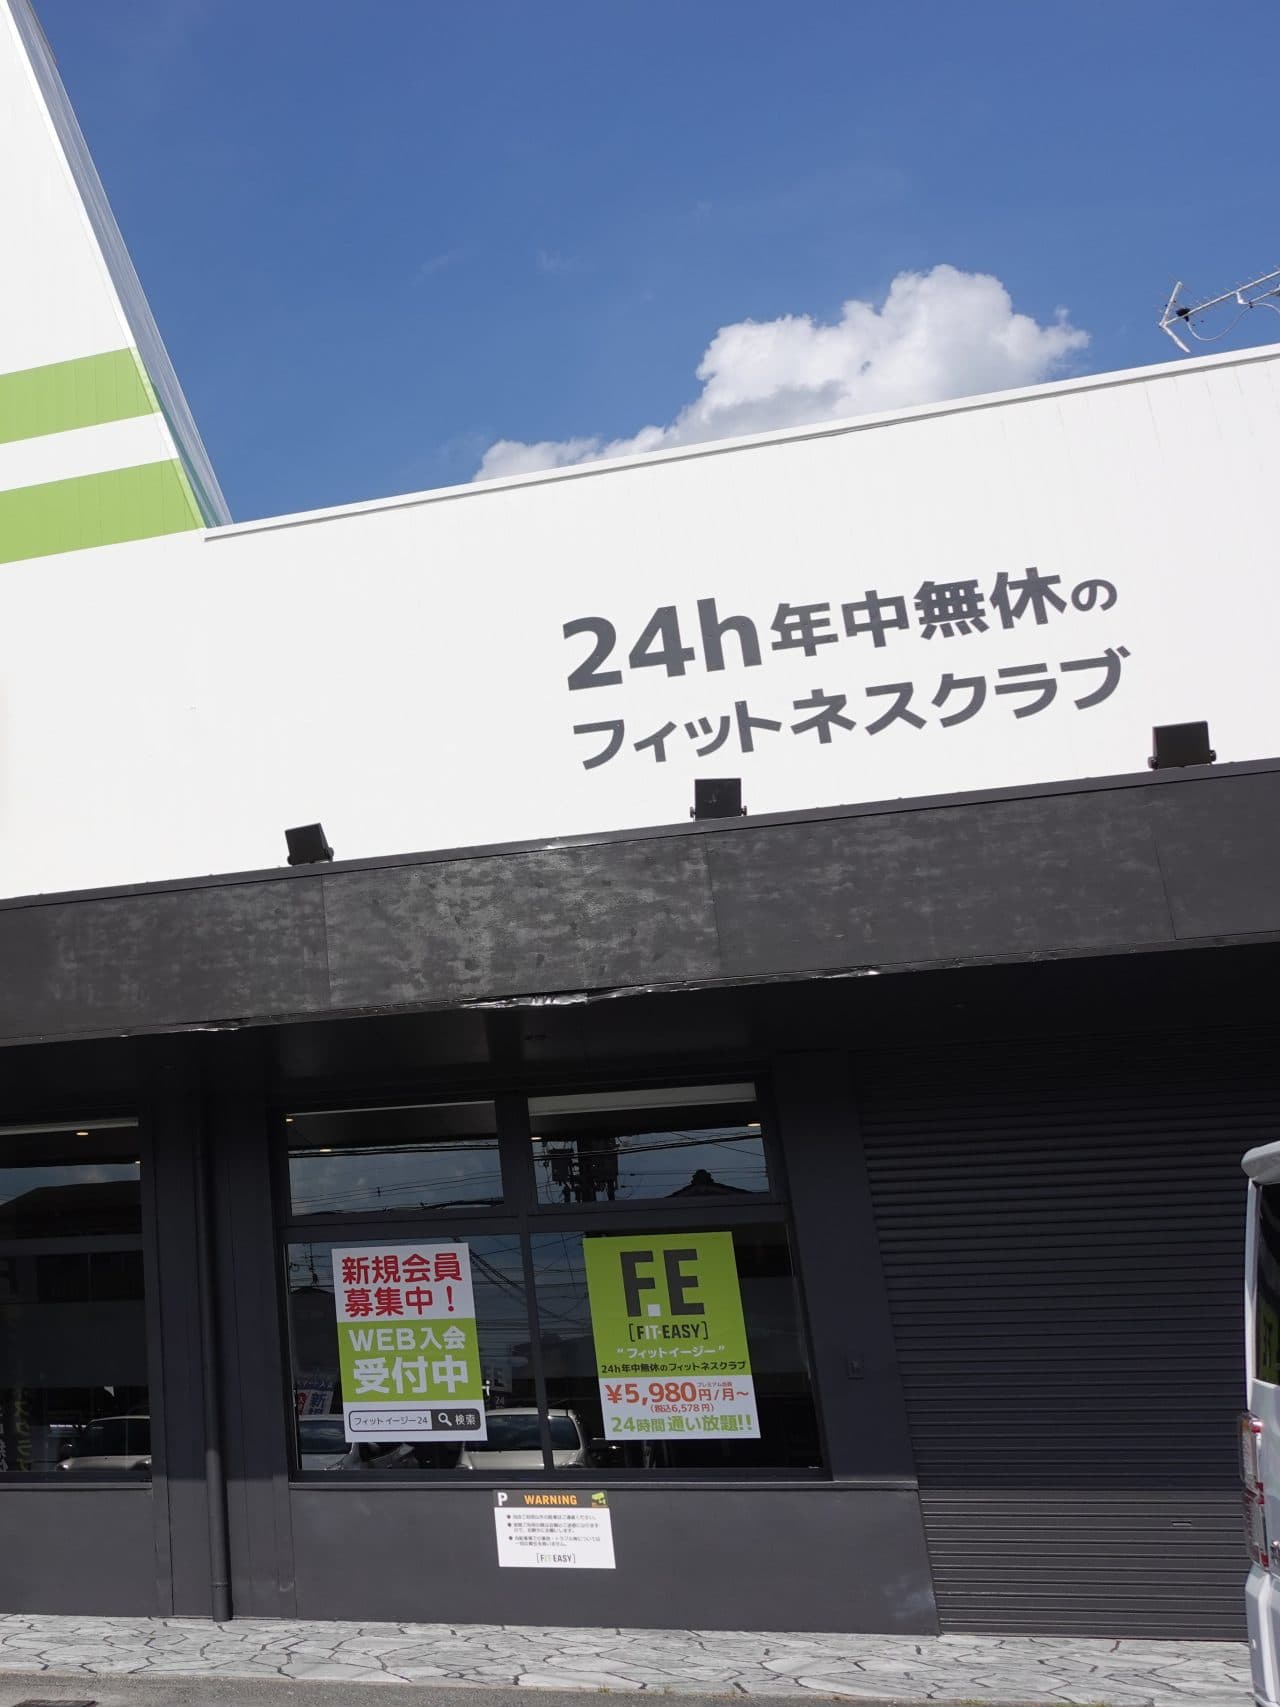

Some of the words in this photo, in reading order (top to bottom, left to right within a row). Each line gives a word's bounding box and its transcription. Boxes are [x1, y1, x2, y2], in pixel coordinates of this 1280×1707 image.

[562, 567, 1118, 692] 24h年中無休の
[573, 645, 1131, 771] フィットネスクラブ
[341, 1252, 463, 1285] 新規会員
[343, 1285, 456, 1318] 募集中!
[347, 1325, 467, 1352] WEB入会
[353, 1354, 469, 1395] 受付中
[454, 1413, 477, 1426] 検索
[497, 1492, 508, 1506] P
[524, 1494, 578, 1505] WARNING
